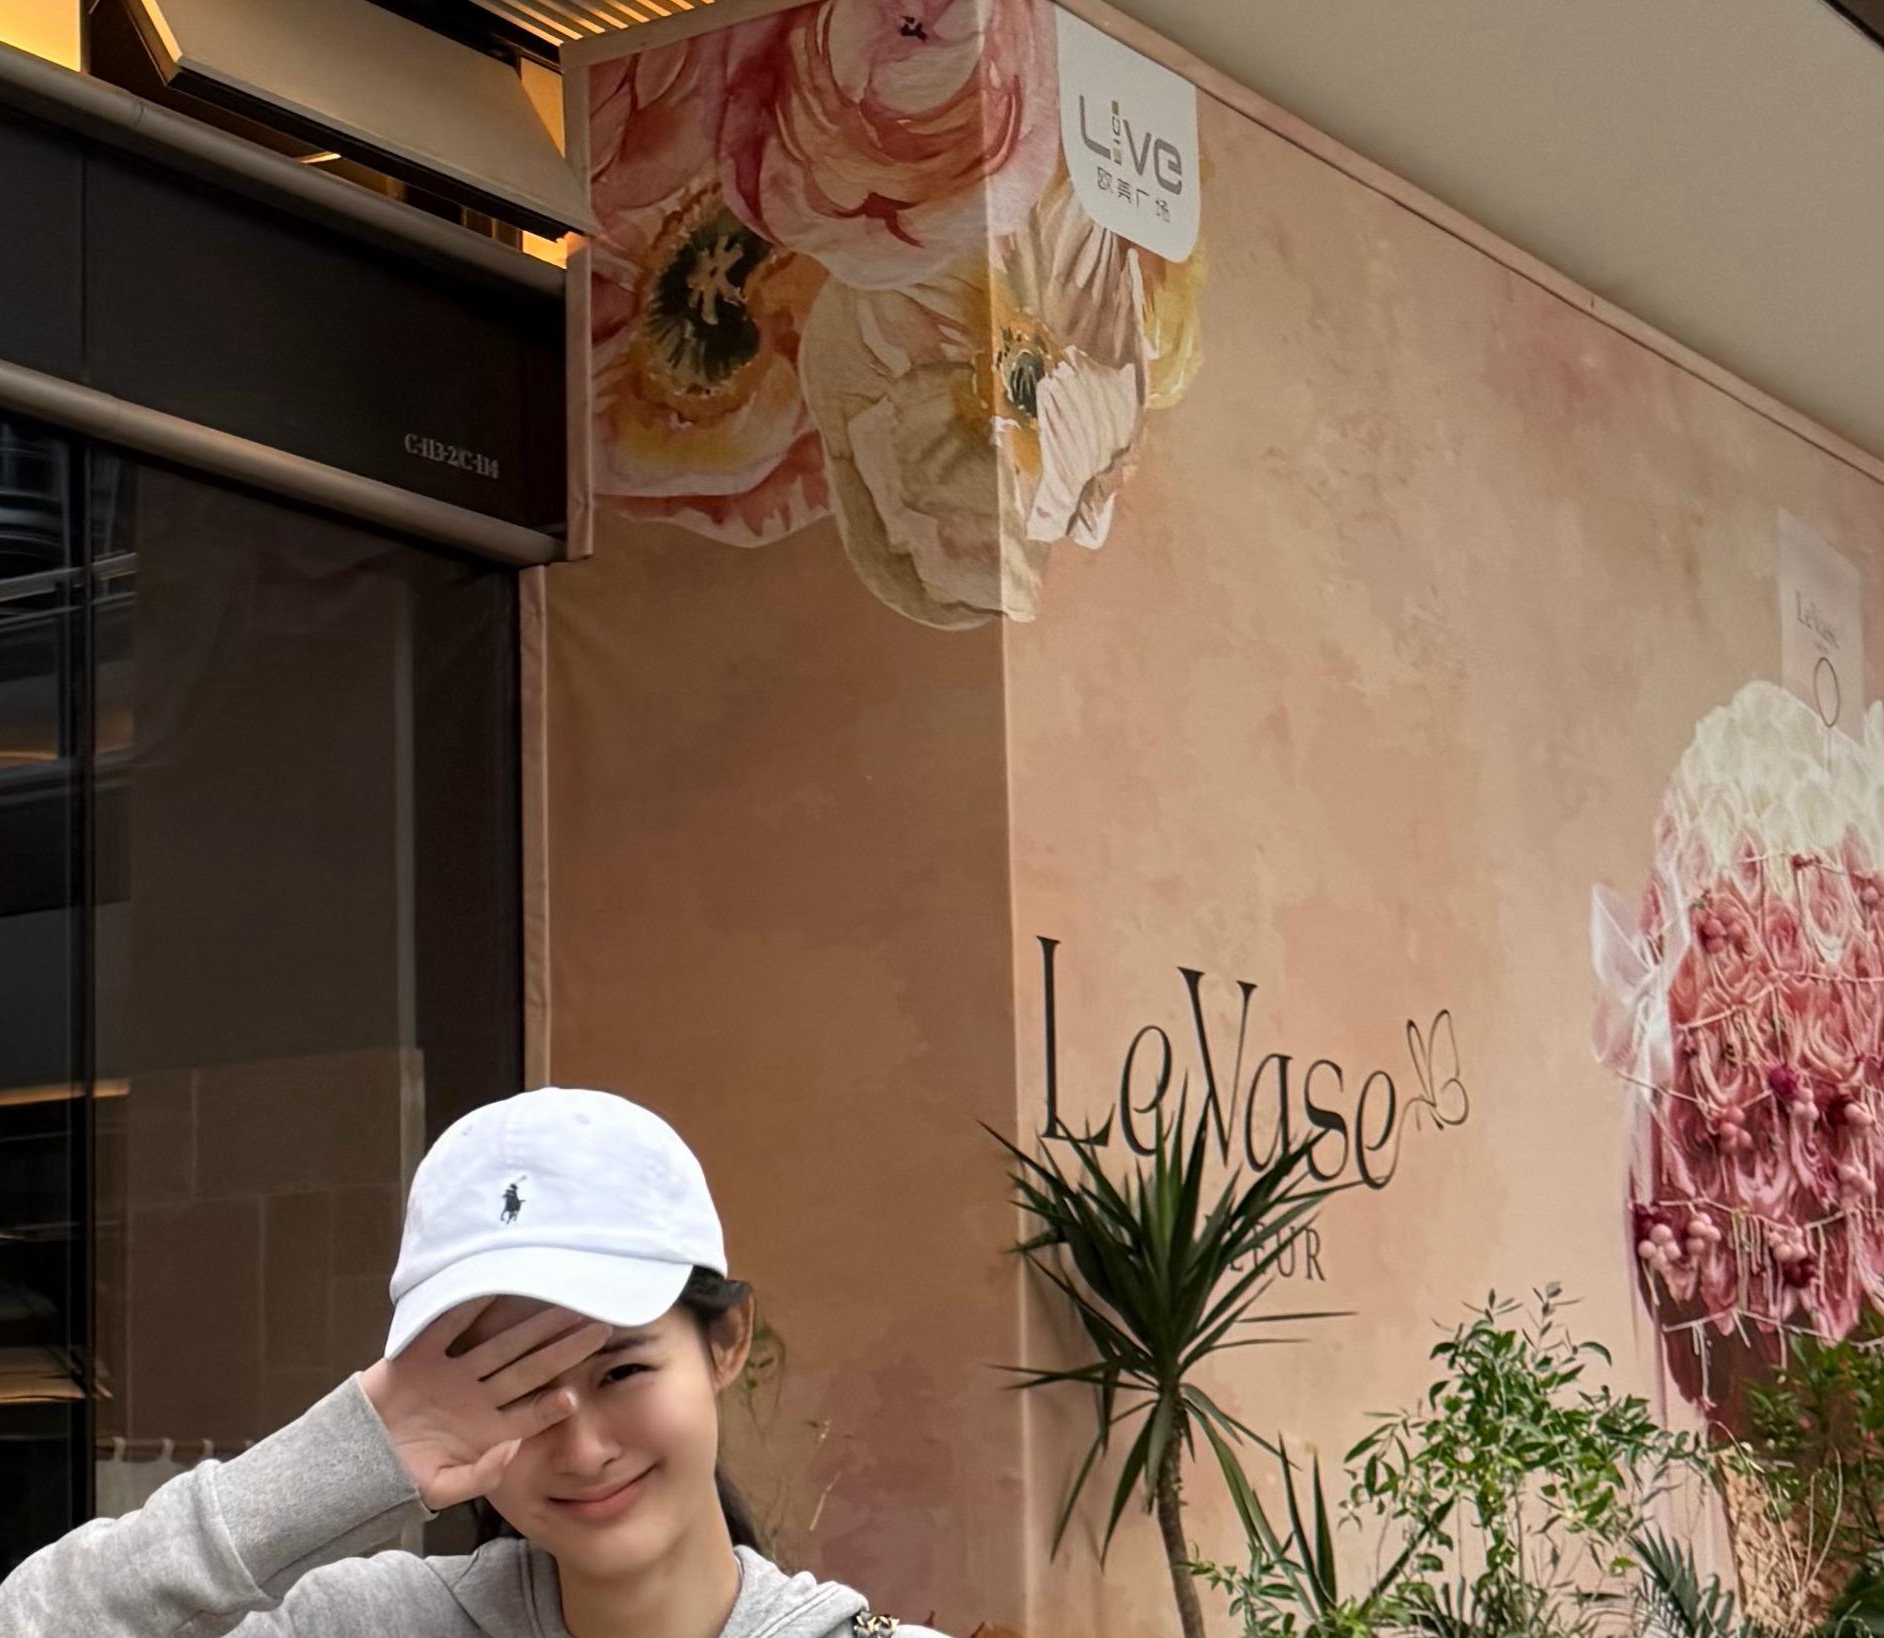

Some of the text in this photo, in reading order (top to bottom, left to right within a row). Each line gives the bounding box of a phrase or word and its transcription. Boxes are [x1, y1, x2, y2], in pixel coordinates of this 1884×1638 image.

[1079, 95, 1183, 195] Live
[1097, 166, 1171, 223] 欧美广场
